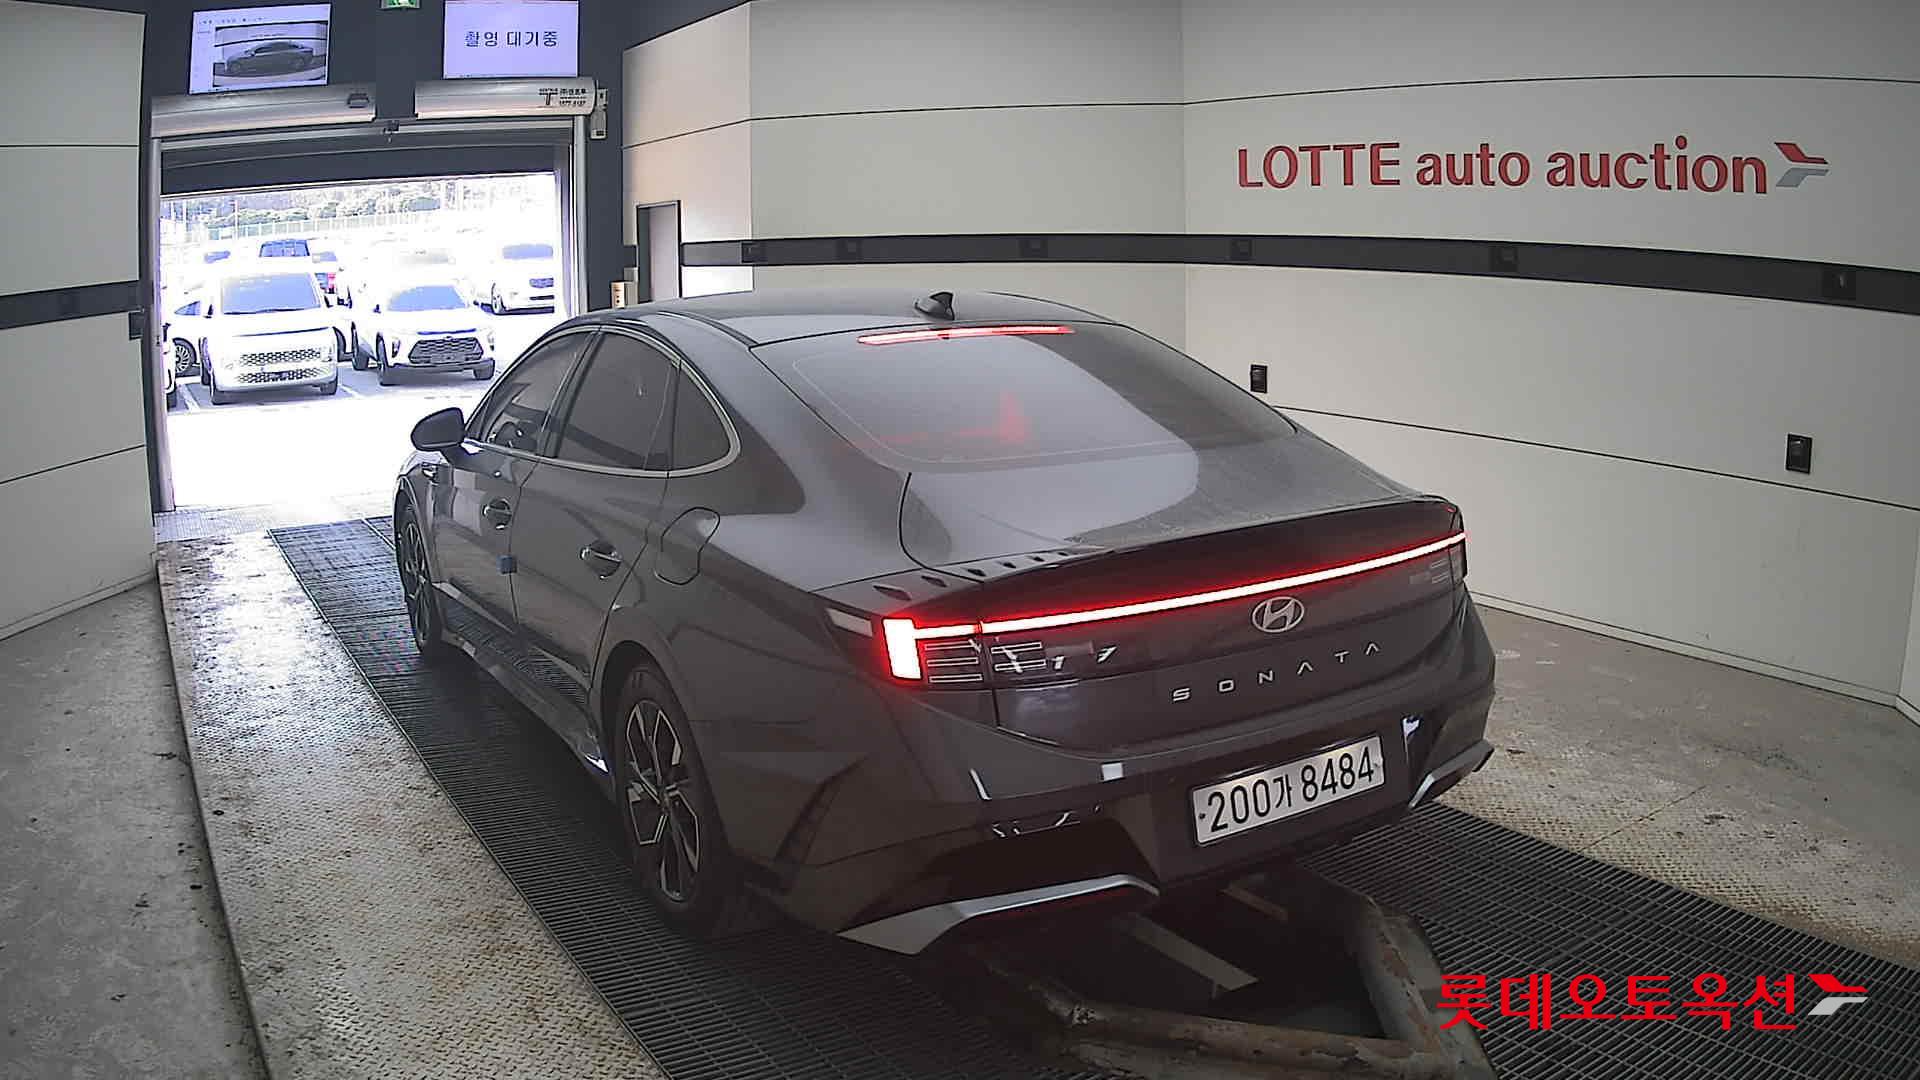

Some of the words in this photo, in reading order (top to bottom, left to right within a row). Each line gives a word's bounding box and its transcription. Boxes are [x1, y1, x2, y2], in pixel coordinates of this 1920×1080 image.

[465, 31, 498, 47] 촬영
[506, 31, 558, 47] 대기중
[1238, 142, 1400, 189] LOTTE
[1416, 143, 1530, 187] auto
[1546, 135, 1768, 194] auction
[1173, 642, 1379, 701] SONATA
